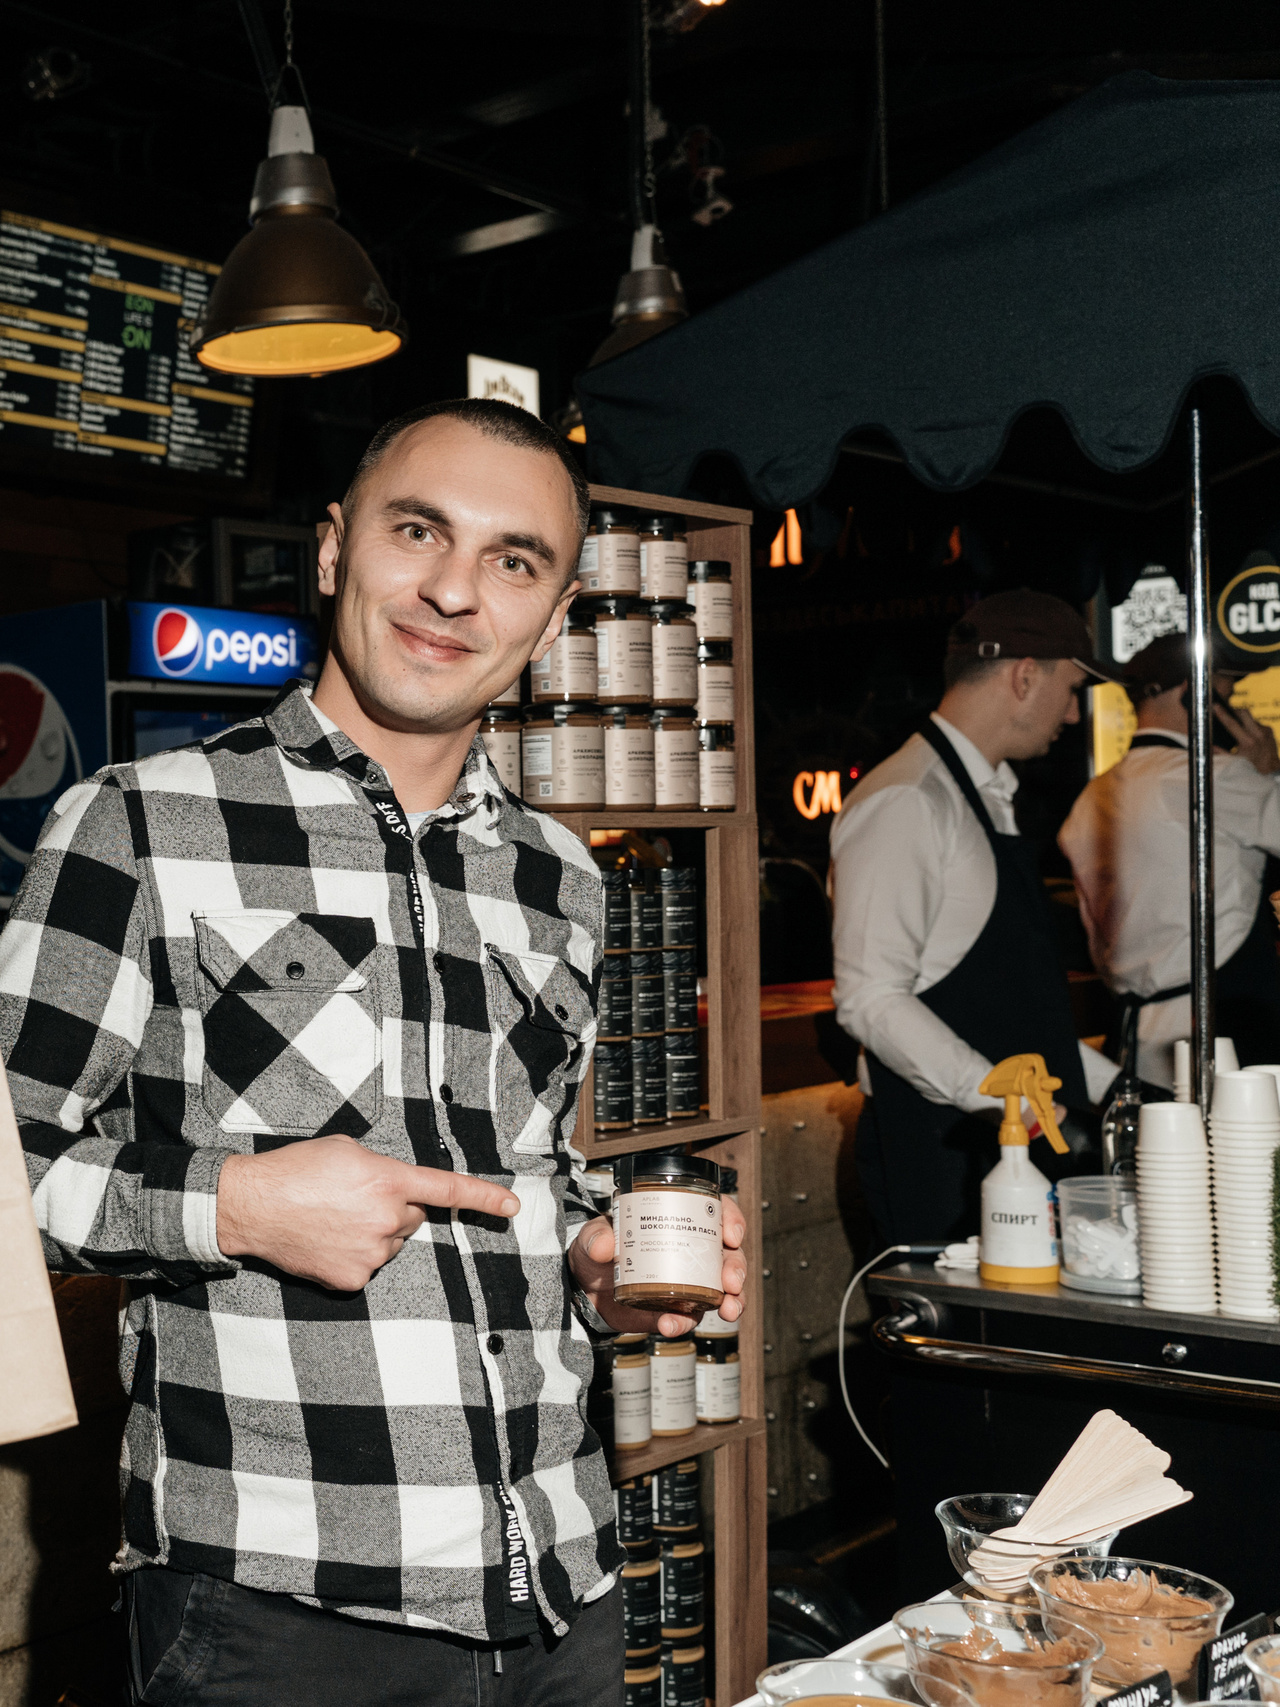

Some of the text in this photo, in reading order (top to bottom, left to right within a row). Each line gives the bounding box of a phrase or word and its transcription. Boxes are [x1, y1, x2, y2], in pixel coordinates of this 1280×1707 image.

[121, 324, 152, 351] ON
[205, 628, 297, 673] pepsi
[640, 1223, 717, 1236] ШОКОЛАДНАЯ ПАСТА
[991, 1212, 1039, 1226] СПИРТ
[505, 1509, 529, 1602] HARD WORK
